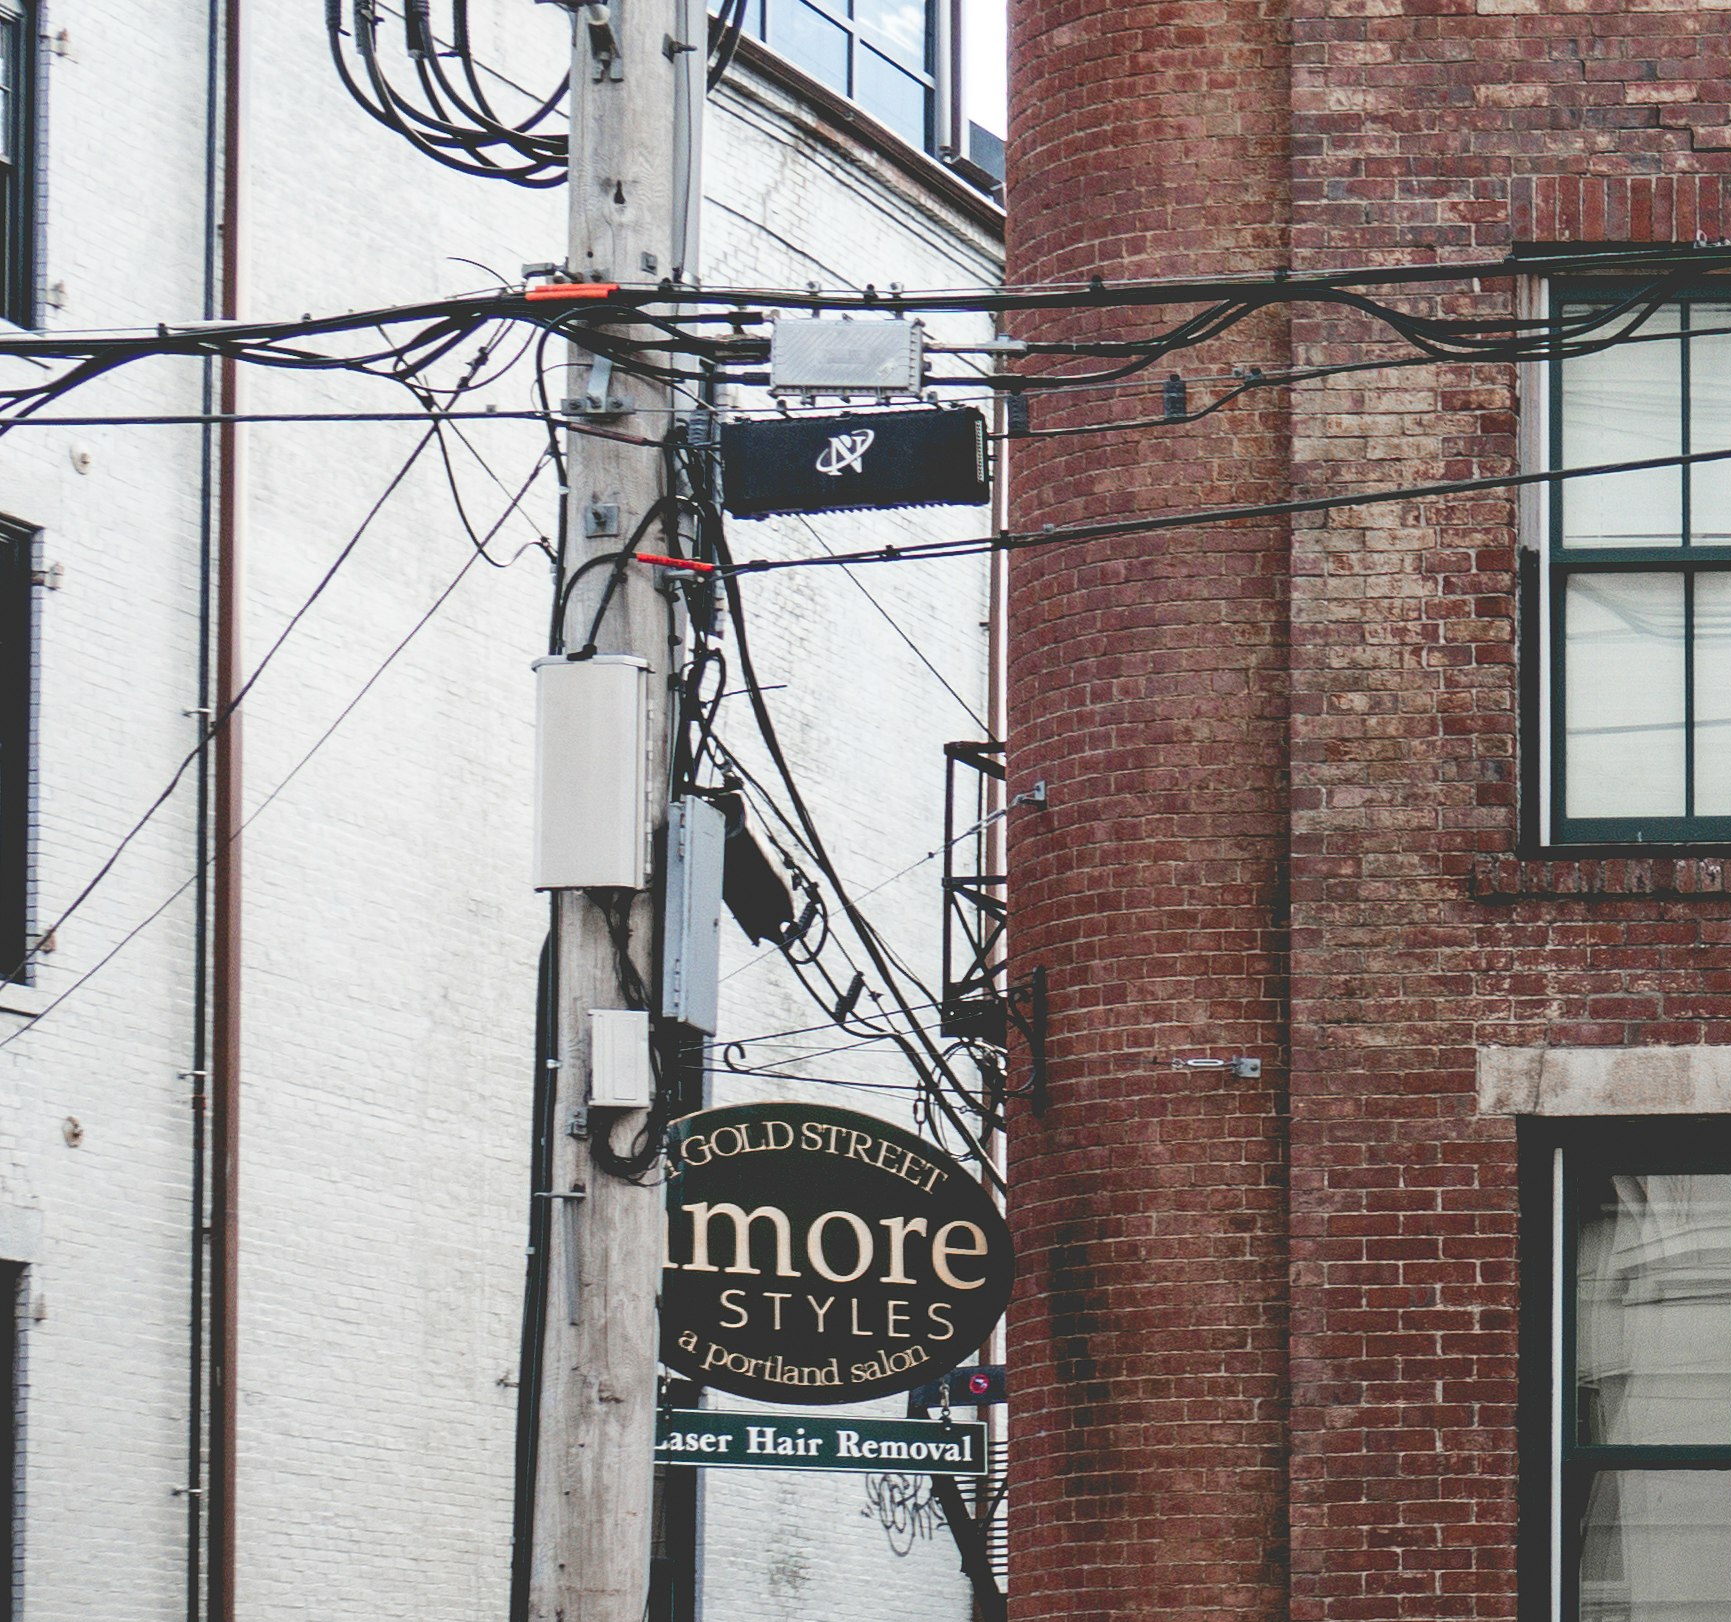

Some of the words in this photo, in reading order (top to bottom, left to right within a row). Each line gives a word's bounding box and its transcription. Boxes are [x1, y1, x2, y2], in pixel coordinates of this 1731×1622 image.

[680, 1120, 795, 1166] GOLD
[800, 1121, 949, 1195] STREET
[718, 1289, 955, 1340] STYLES
[677, 1330, 697, 1353] a
[700, 1342, 844, 1387] portland
[850, 1345, 931, 1384] salon
[746, 1426, 824, 1457] Hair
[836, 1430, 973, 1462] Removal
